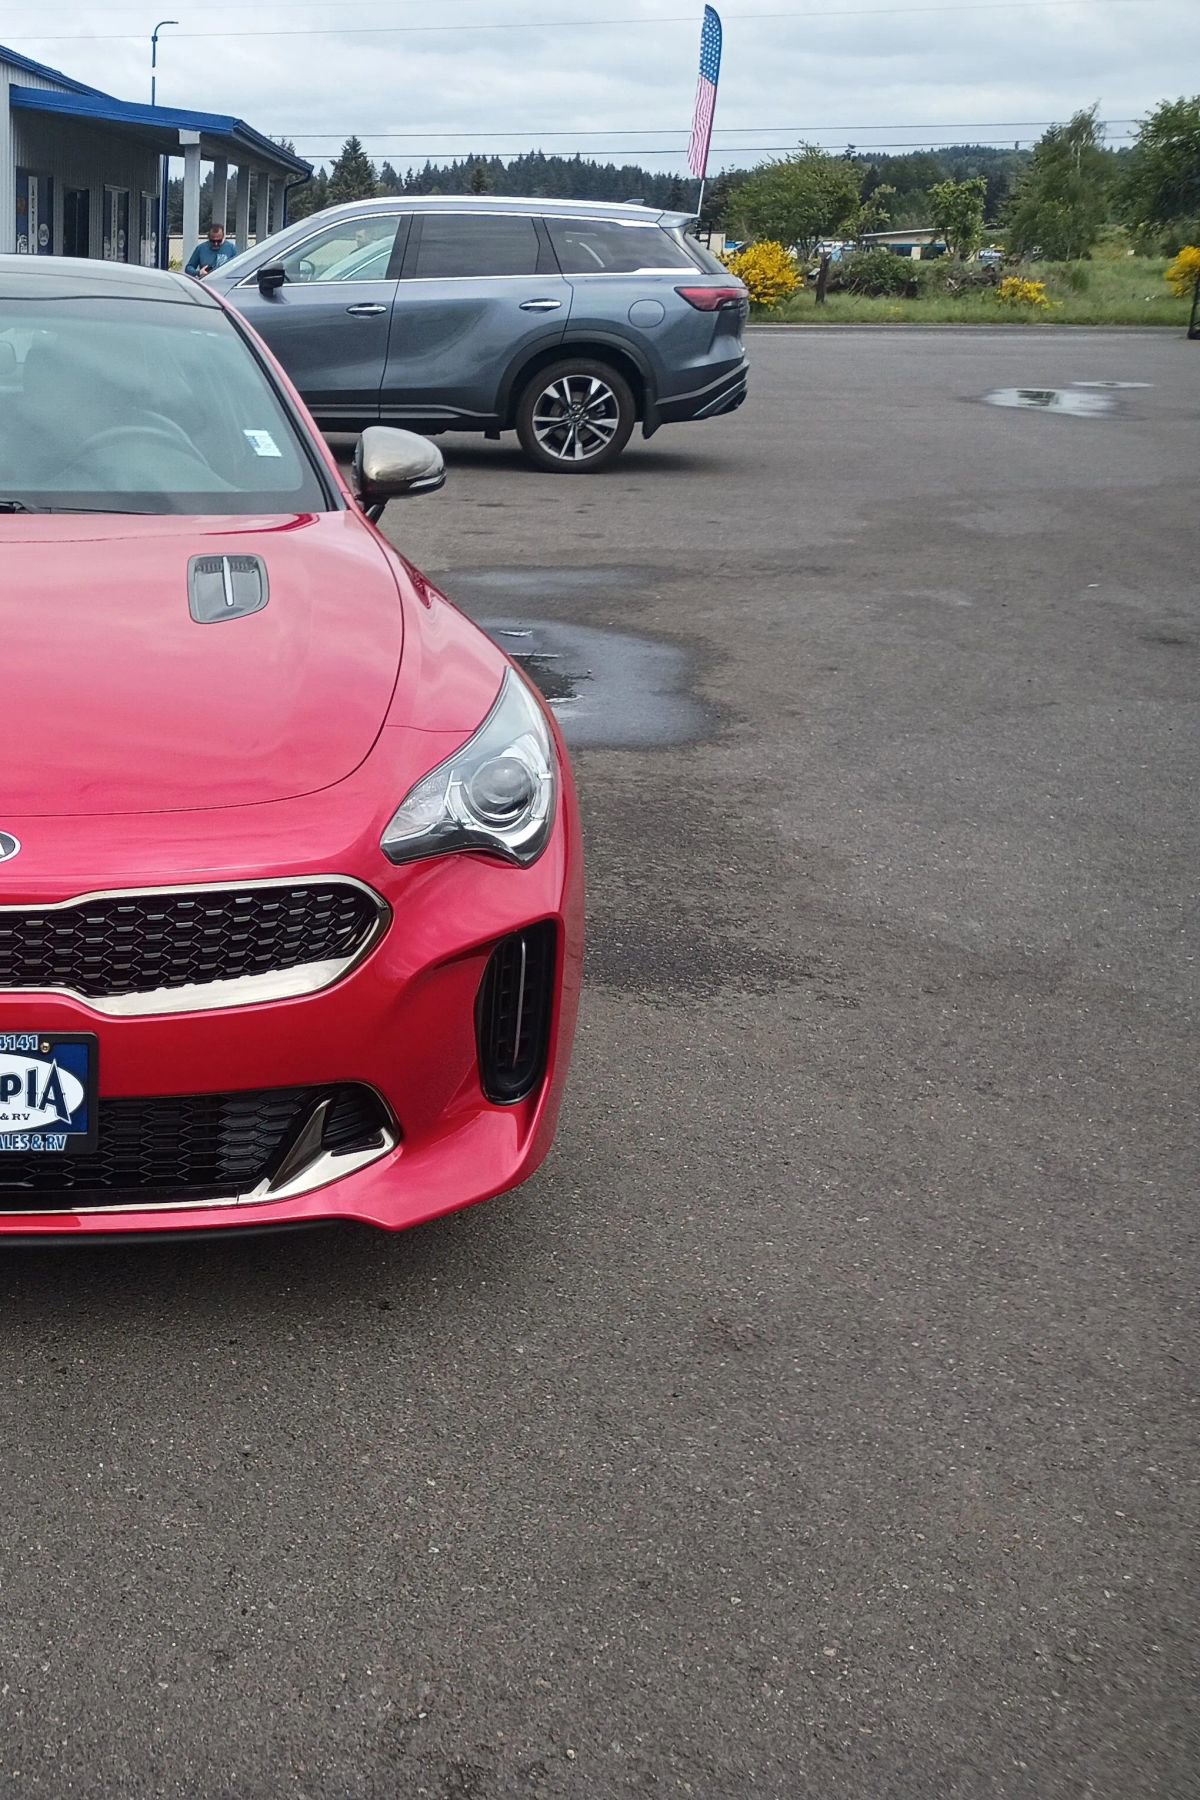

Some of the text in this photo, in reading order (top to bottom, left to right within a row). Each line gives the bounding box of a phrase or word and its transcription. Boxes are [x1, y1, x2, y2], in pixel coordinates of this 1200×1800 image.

[0, 1113, 9, 1121] &
[11, 1112, 31, 1121] RV
[31, 1134, 45, 1151] &
[46, 1134, 68, 1151] RV
